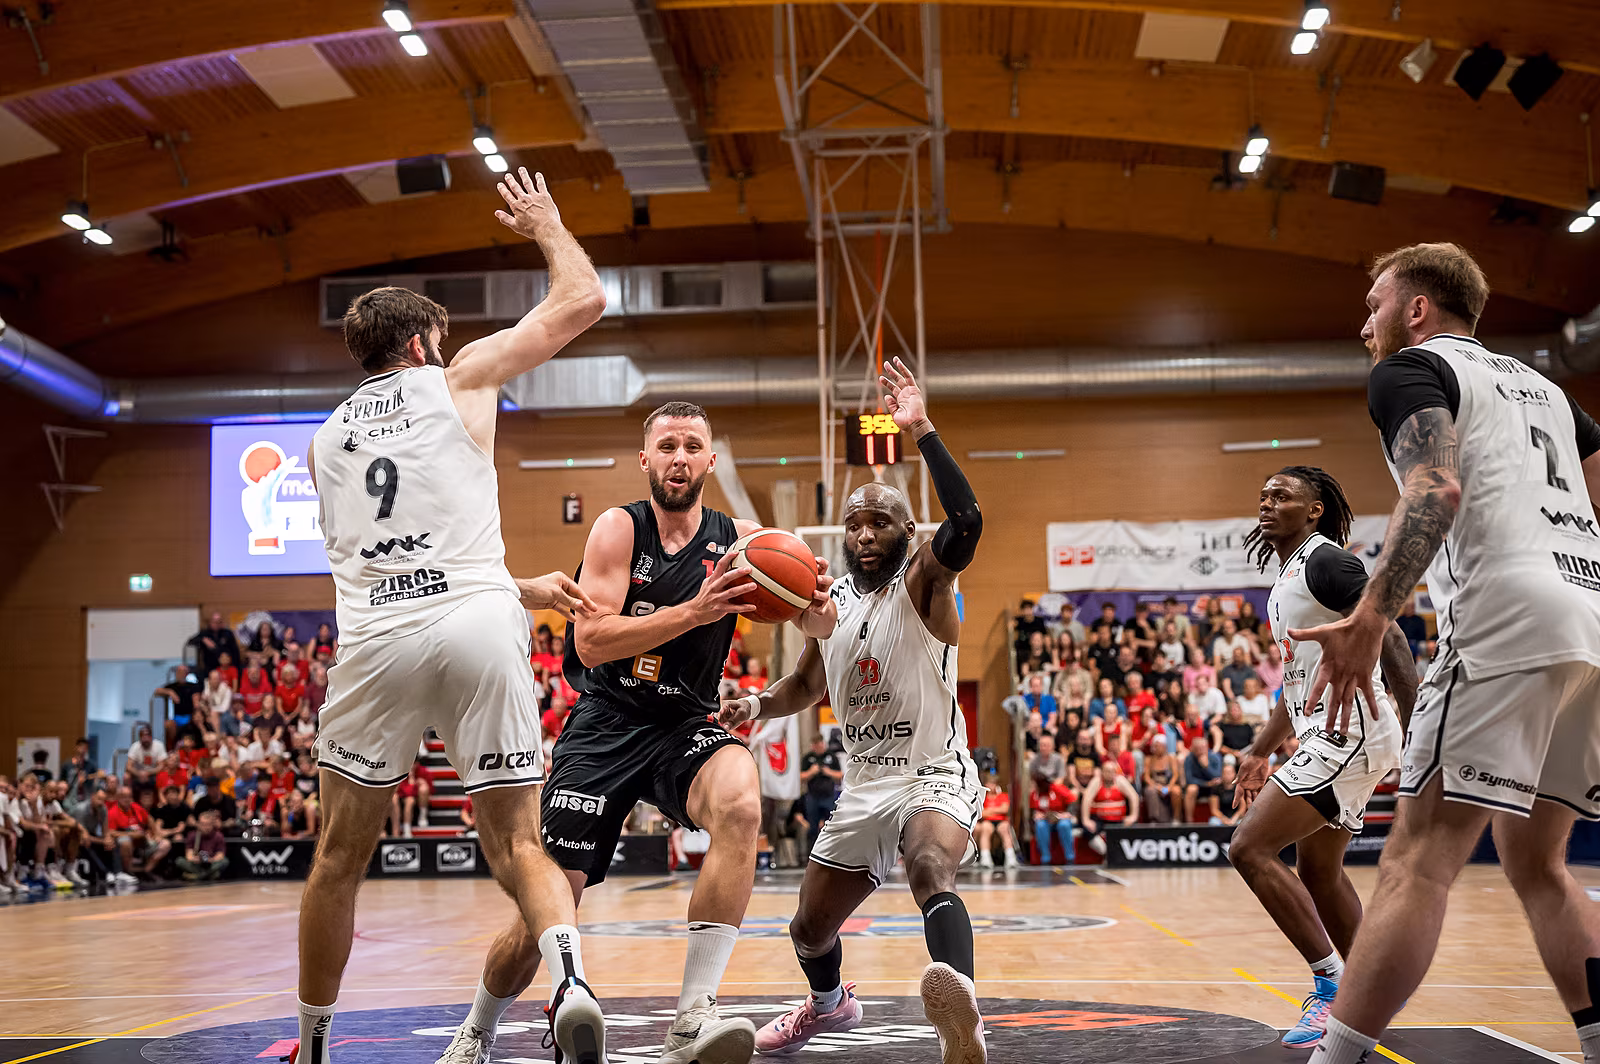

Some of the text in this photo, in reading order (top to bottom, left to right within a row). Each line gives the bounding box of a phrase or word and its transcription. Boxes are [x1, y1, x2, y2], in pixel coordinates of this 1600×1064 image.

[1530, 425, 1572, 494] 2
[365, 456, 399, 522] 9
[370, 568, 445, 598] MIROS
[374, 584, 447, 606] Pardubice a.s.
[337, 746, 386, 770] Synthesia
[1120, 831, 1220, 862] ventio
